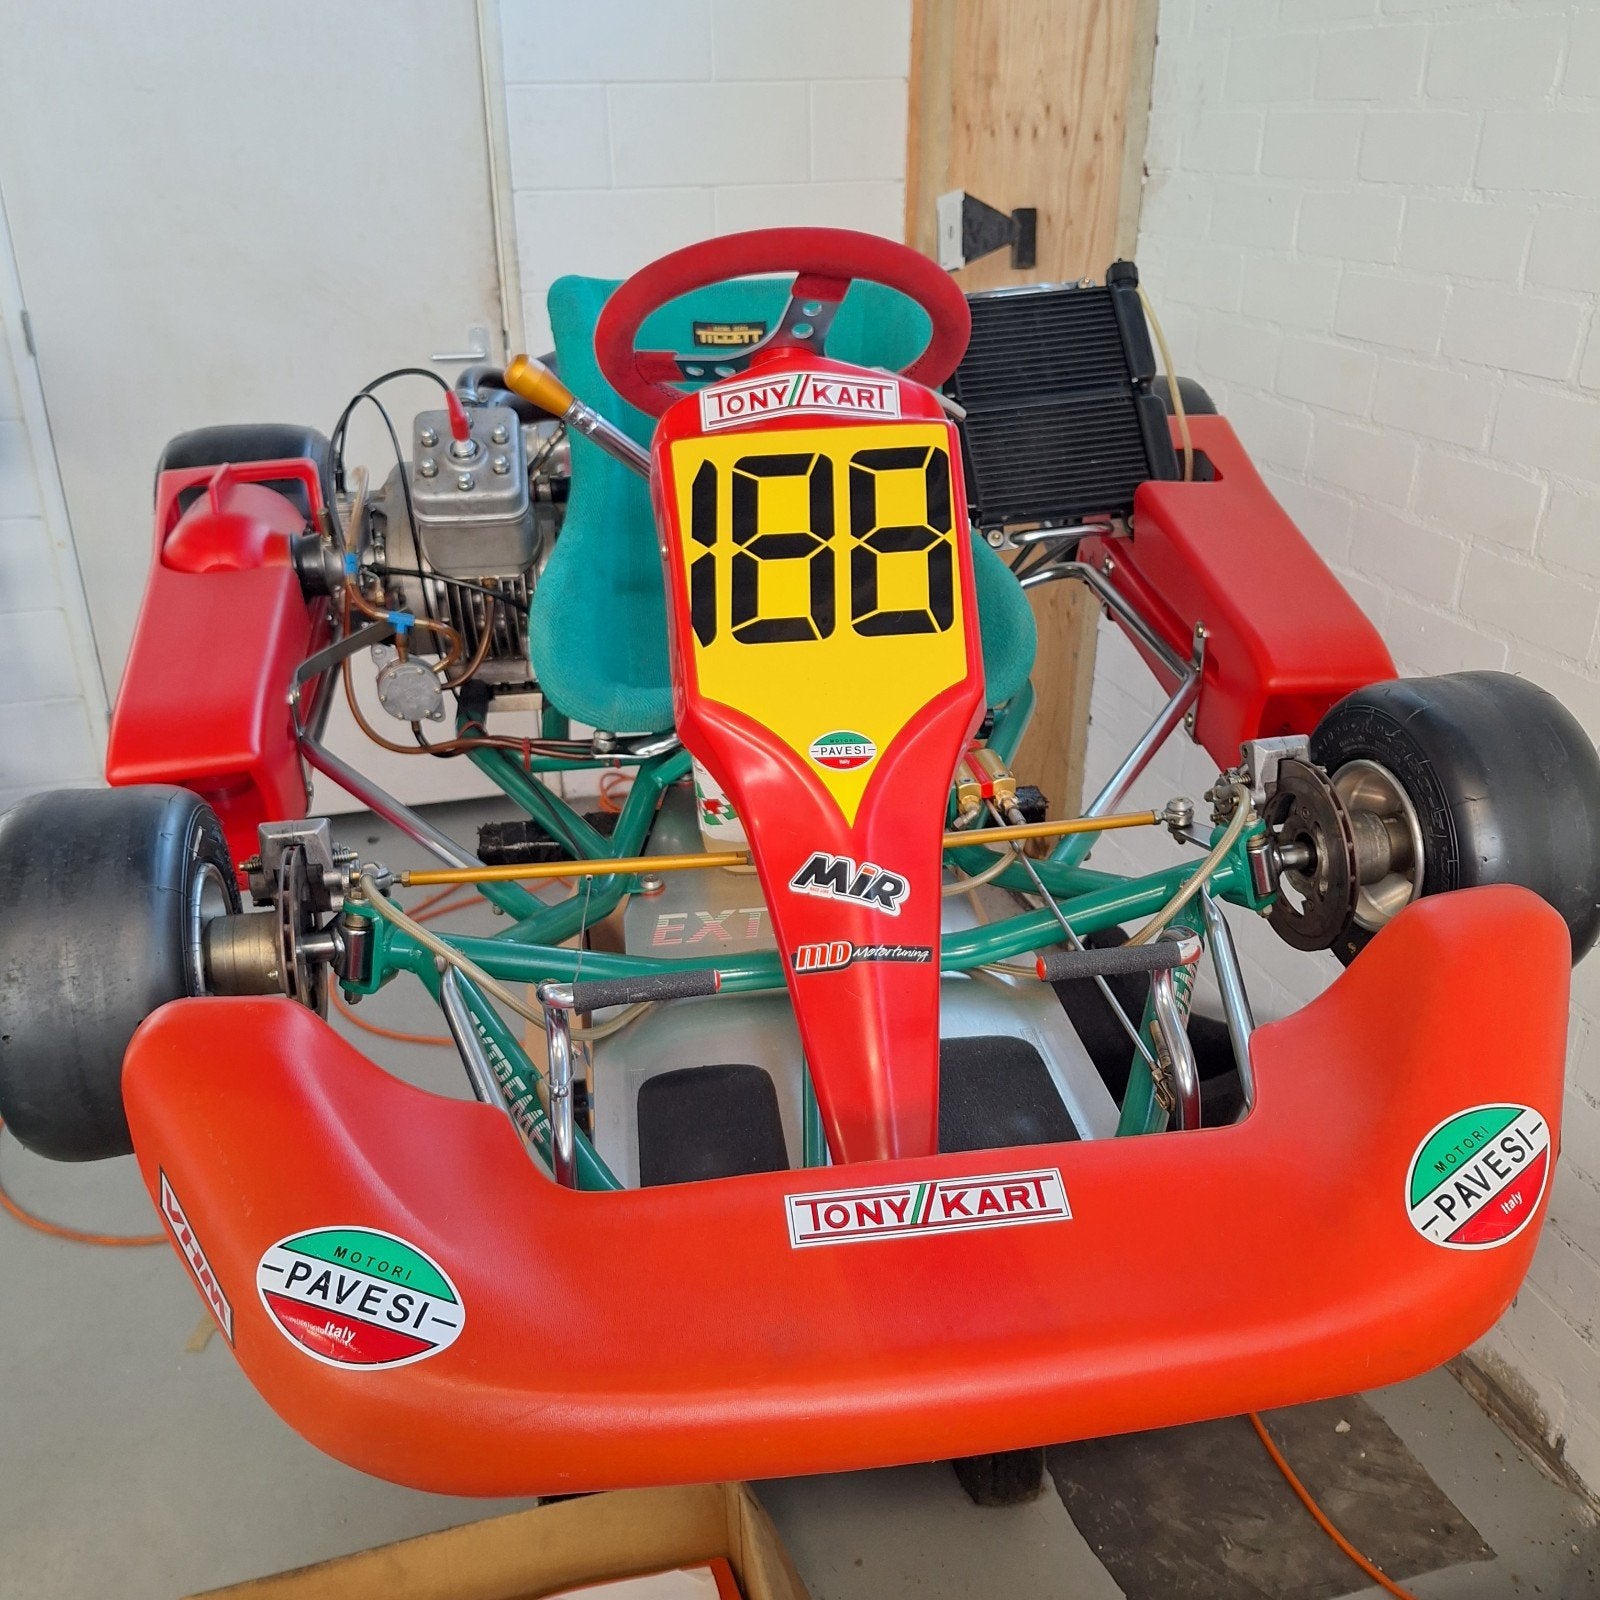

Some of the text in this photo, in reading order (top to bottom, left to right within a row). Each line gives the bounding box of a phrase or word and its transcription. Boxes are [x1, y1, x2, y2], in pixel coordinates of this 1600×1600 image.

[706, 376, 893, 418] TONY KART
[690, 446, 954, 648] 188
[820, 745, 866, 756] PAVESI
[651, 906, 777, 946] EXT
[852, 943, 930, 963] Motortuning
[1433, 1125, 1490, 1174] MOTORI
[1433, 1127, 1535, 1223] PAVESI
[795, 1175, 1054, 1232] TONY KART
[1500, 1191, 1524, 1216] Italy
[333, 1245, 414, 1281] MOTORI
[284, 1260, 431, 1330] PAVESI
[323, 1320, 357, 1347] Italy
